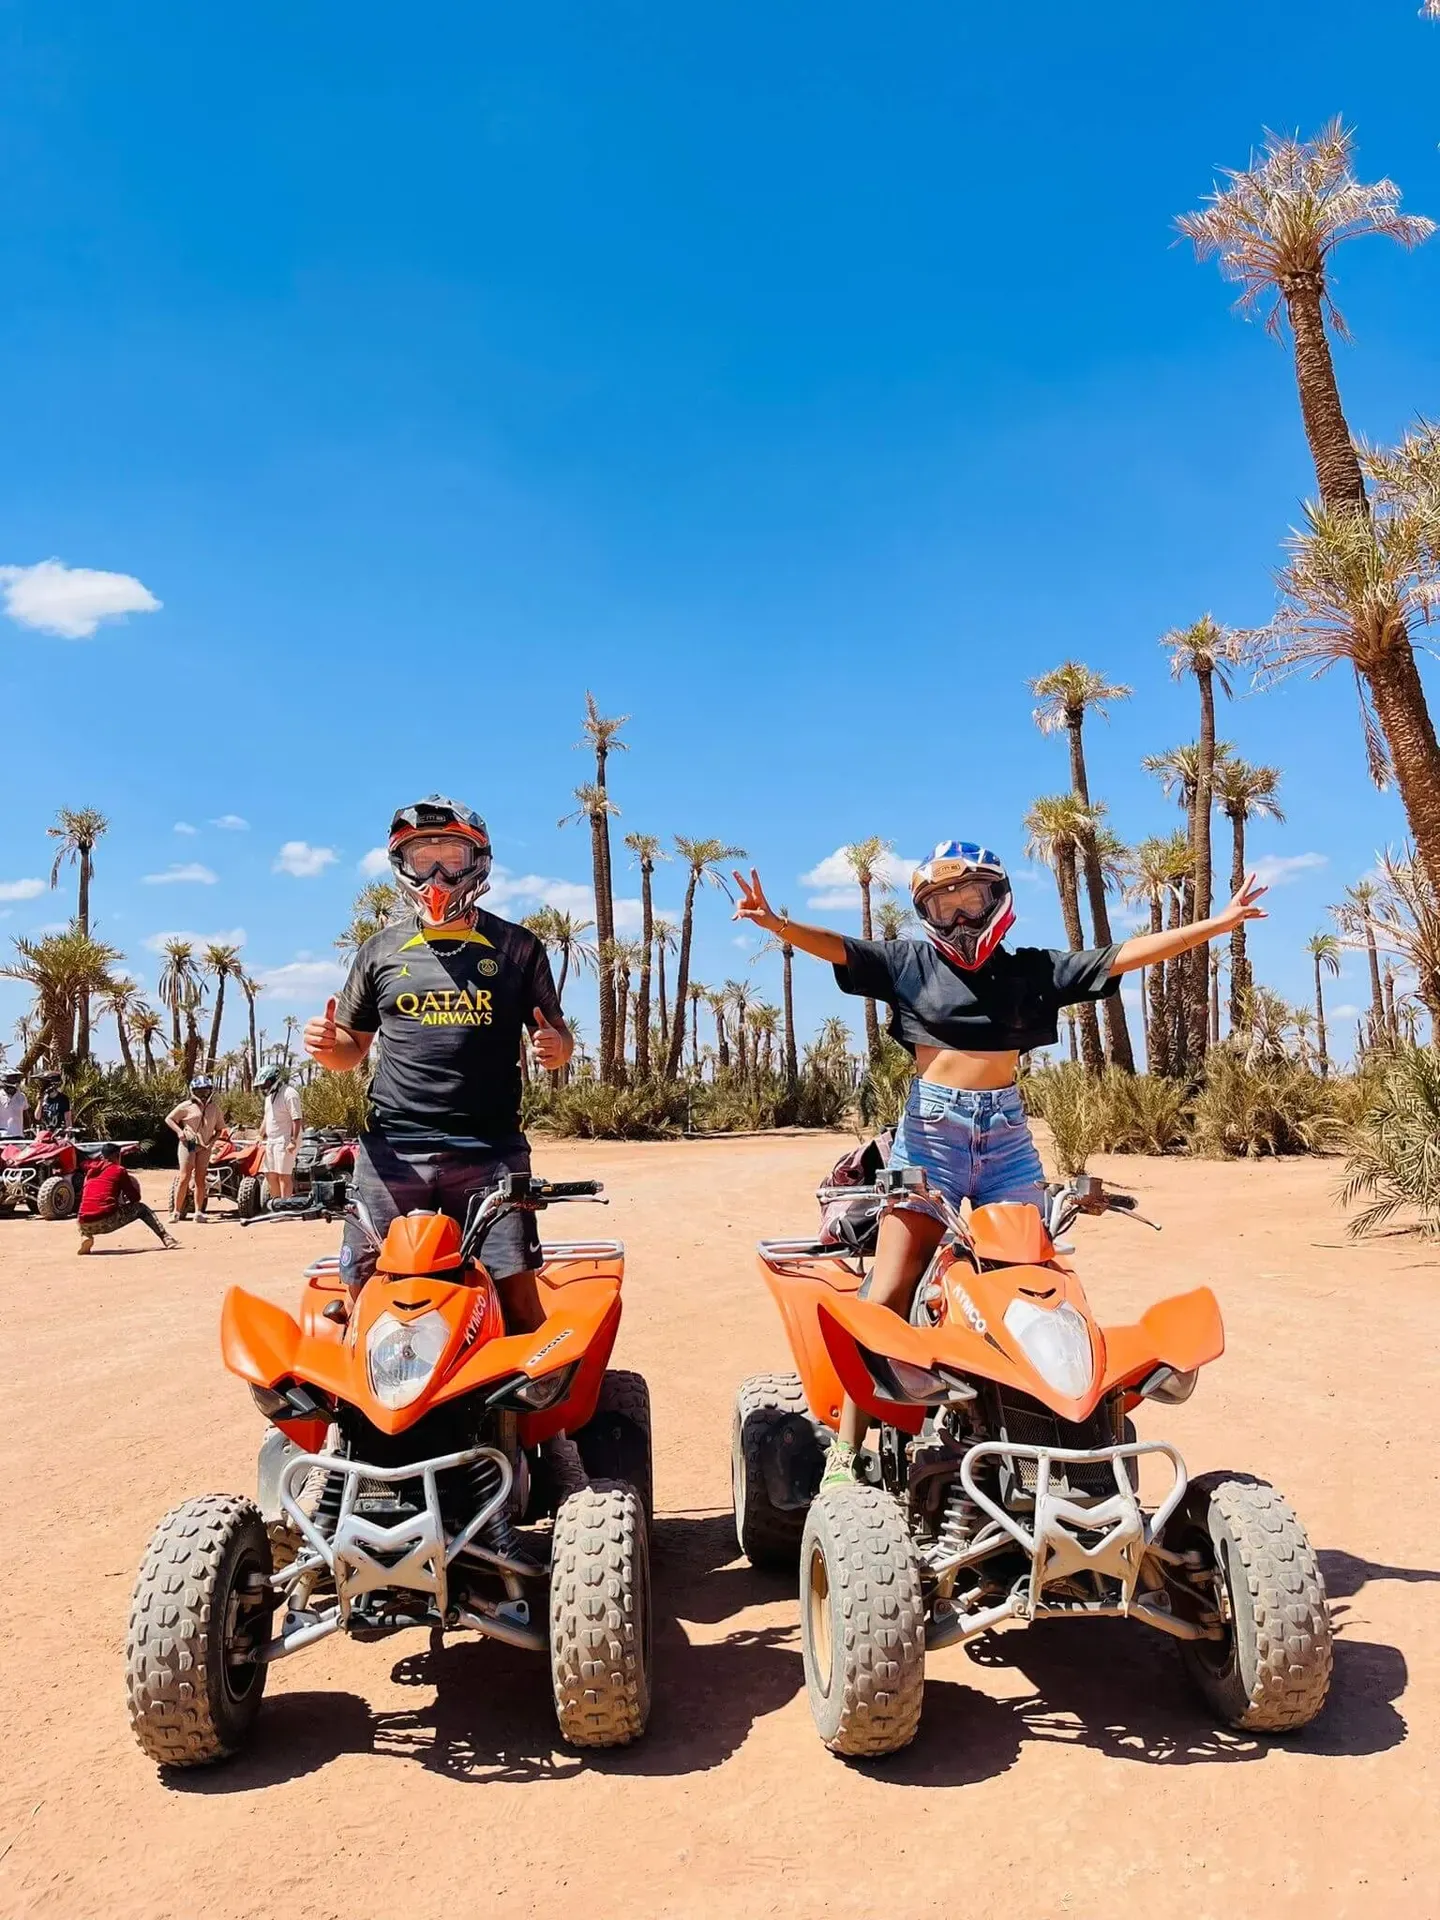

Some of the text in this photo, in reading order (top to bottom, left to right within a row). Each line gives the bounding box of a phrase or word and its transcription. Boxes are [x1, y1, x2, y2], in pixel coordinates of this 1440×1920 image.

[396, 989, 493, 1017] QATAR
[420, 1011, 493, 1026] AIRWAYS
[463, 1294, 487, 1346] KYMCO
[952, 1283, 987, 1333] KYMCO
